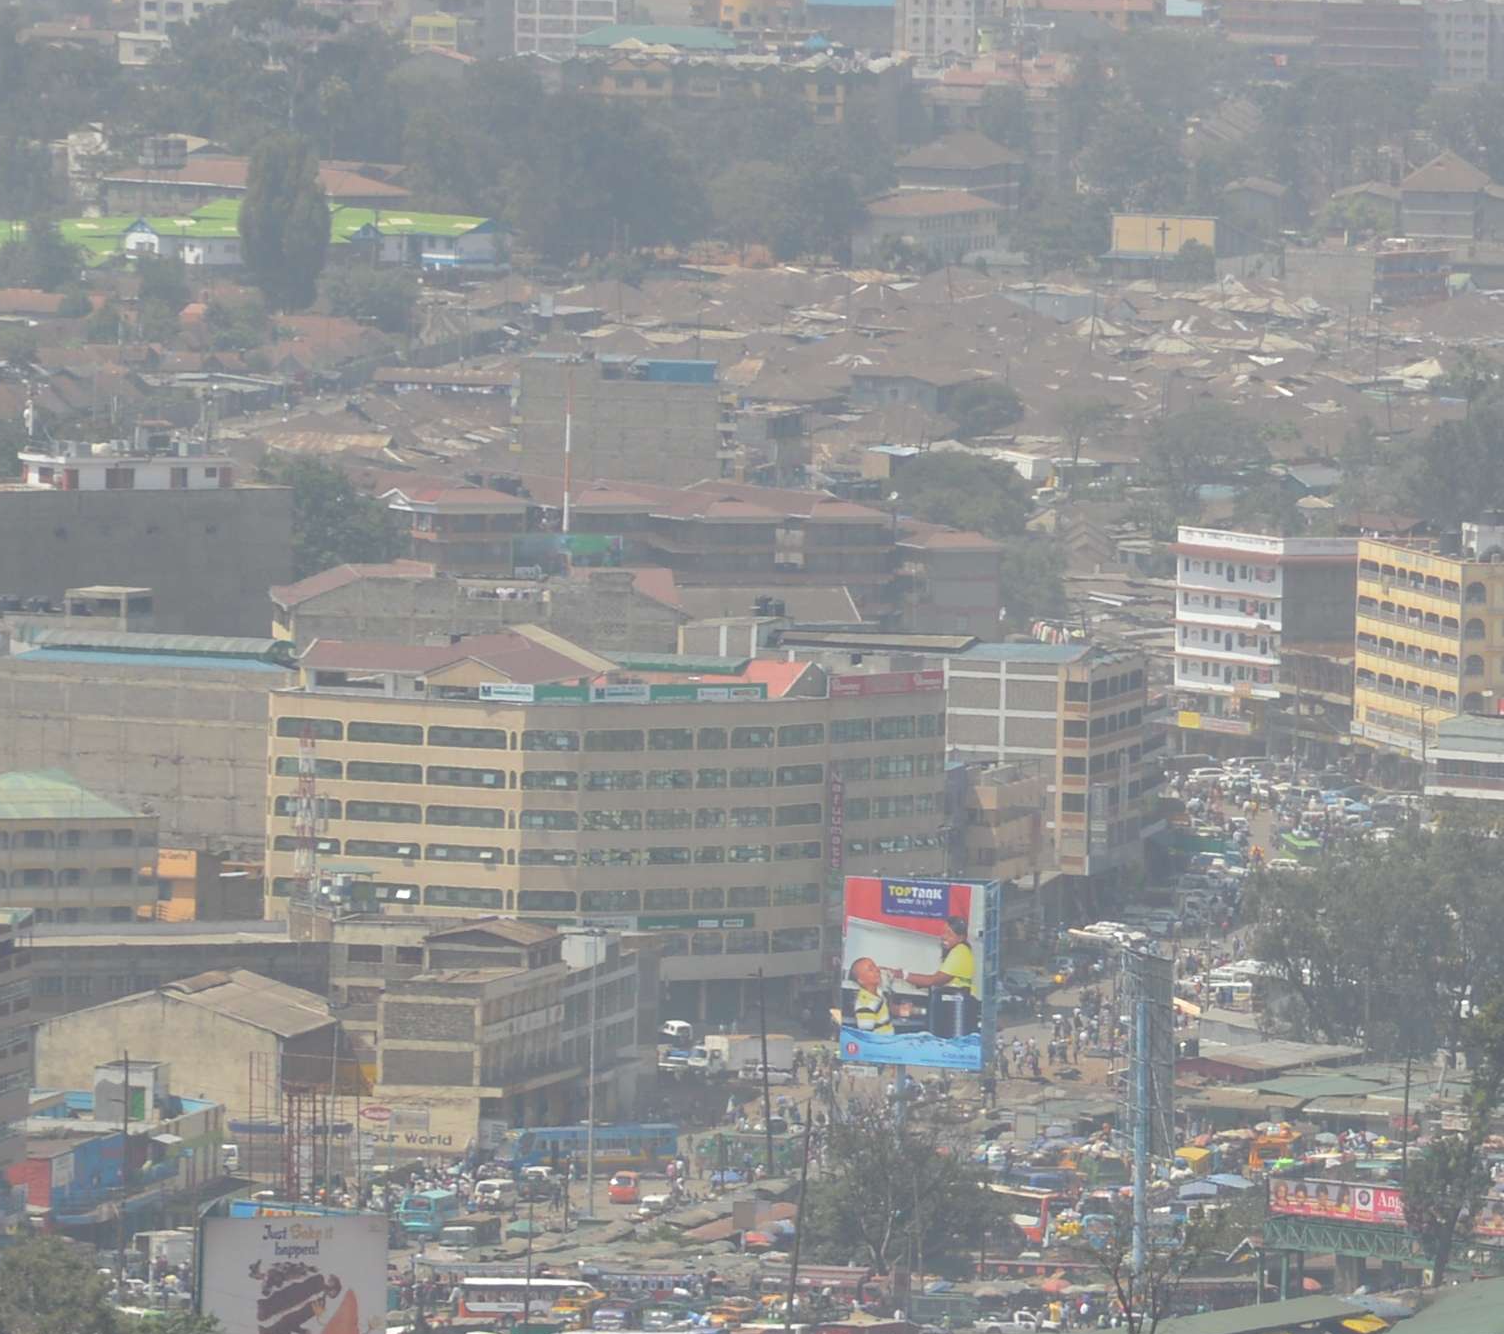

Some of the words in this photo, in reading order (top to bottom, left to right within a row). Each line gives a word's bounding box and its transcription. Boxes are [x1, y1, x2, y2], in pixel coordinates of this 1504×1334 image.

[405, 1132, 453, 1146] World
[262, 1225, 287, 1240] Just
[274, 1241, 320, 1258] happen!
